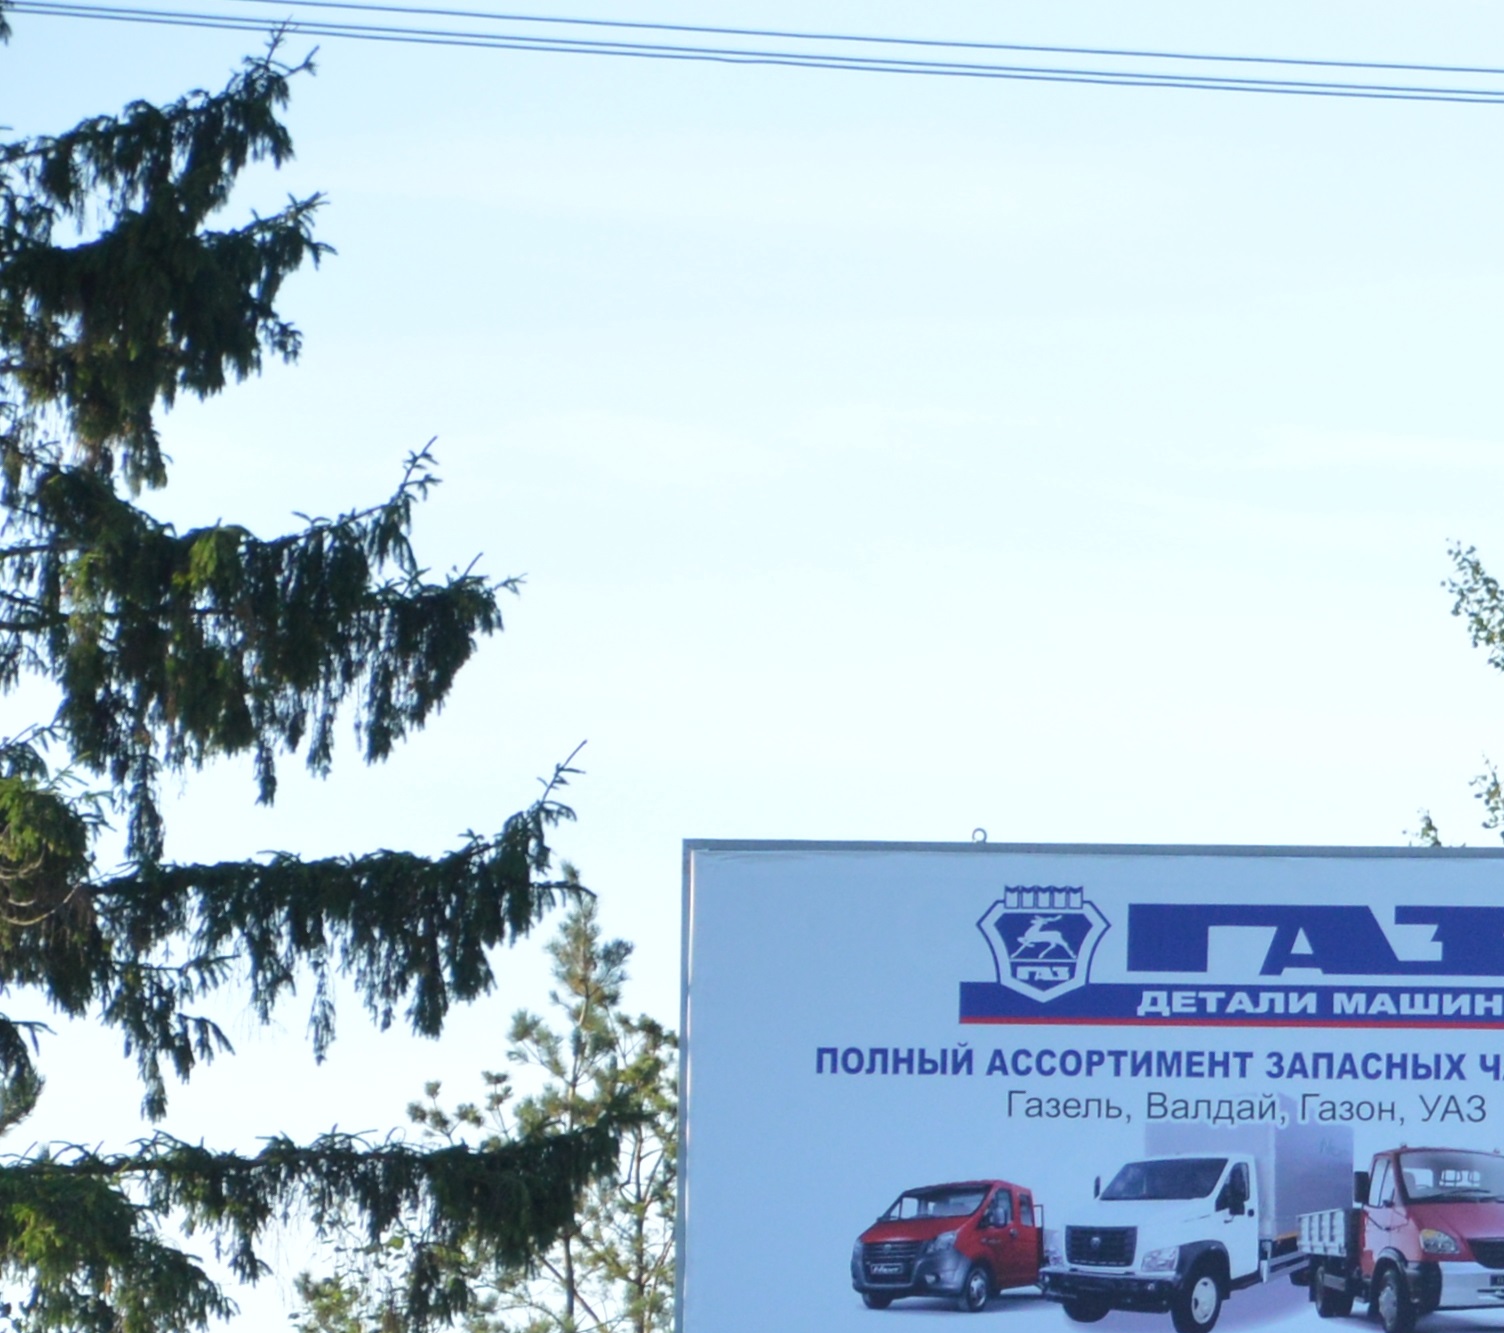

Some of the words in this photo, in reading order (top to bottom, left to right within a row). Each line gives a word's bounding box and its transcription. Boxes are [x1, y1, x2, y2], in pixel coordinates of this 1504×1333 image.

[1016, 966, 1071, 981] ГАЗ
[1136, 990, 1317, 1017] ДЕТАЛИ
[1333, 992, 1503, 1016] МАШИН
[815, 1042, 974, 1076] ПОЛНЫЙ
[985, 1048, 1254, 1079] АССОРТИМЕНТ
[1265, 1051, 1467, 1081] ЗАПАСНЫХ
[1006, 1090, 1132, 1123] Газель,
[1146, 1091, 1287, 1125] Валдай,
[1300, 1093, 1406, 1126] Газон,
[1418, 1094, 1488, 1123] УАЗ
